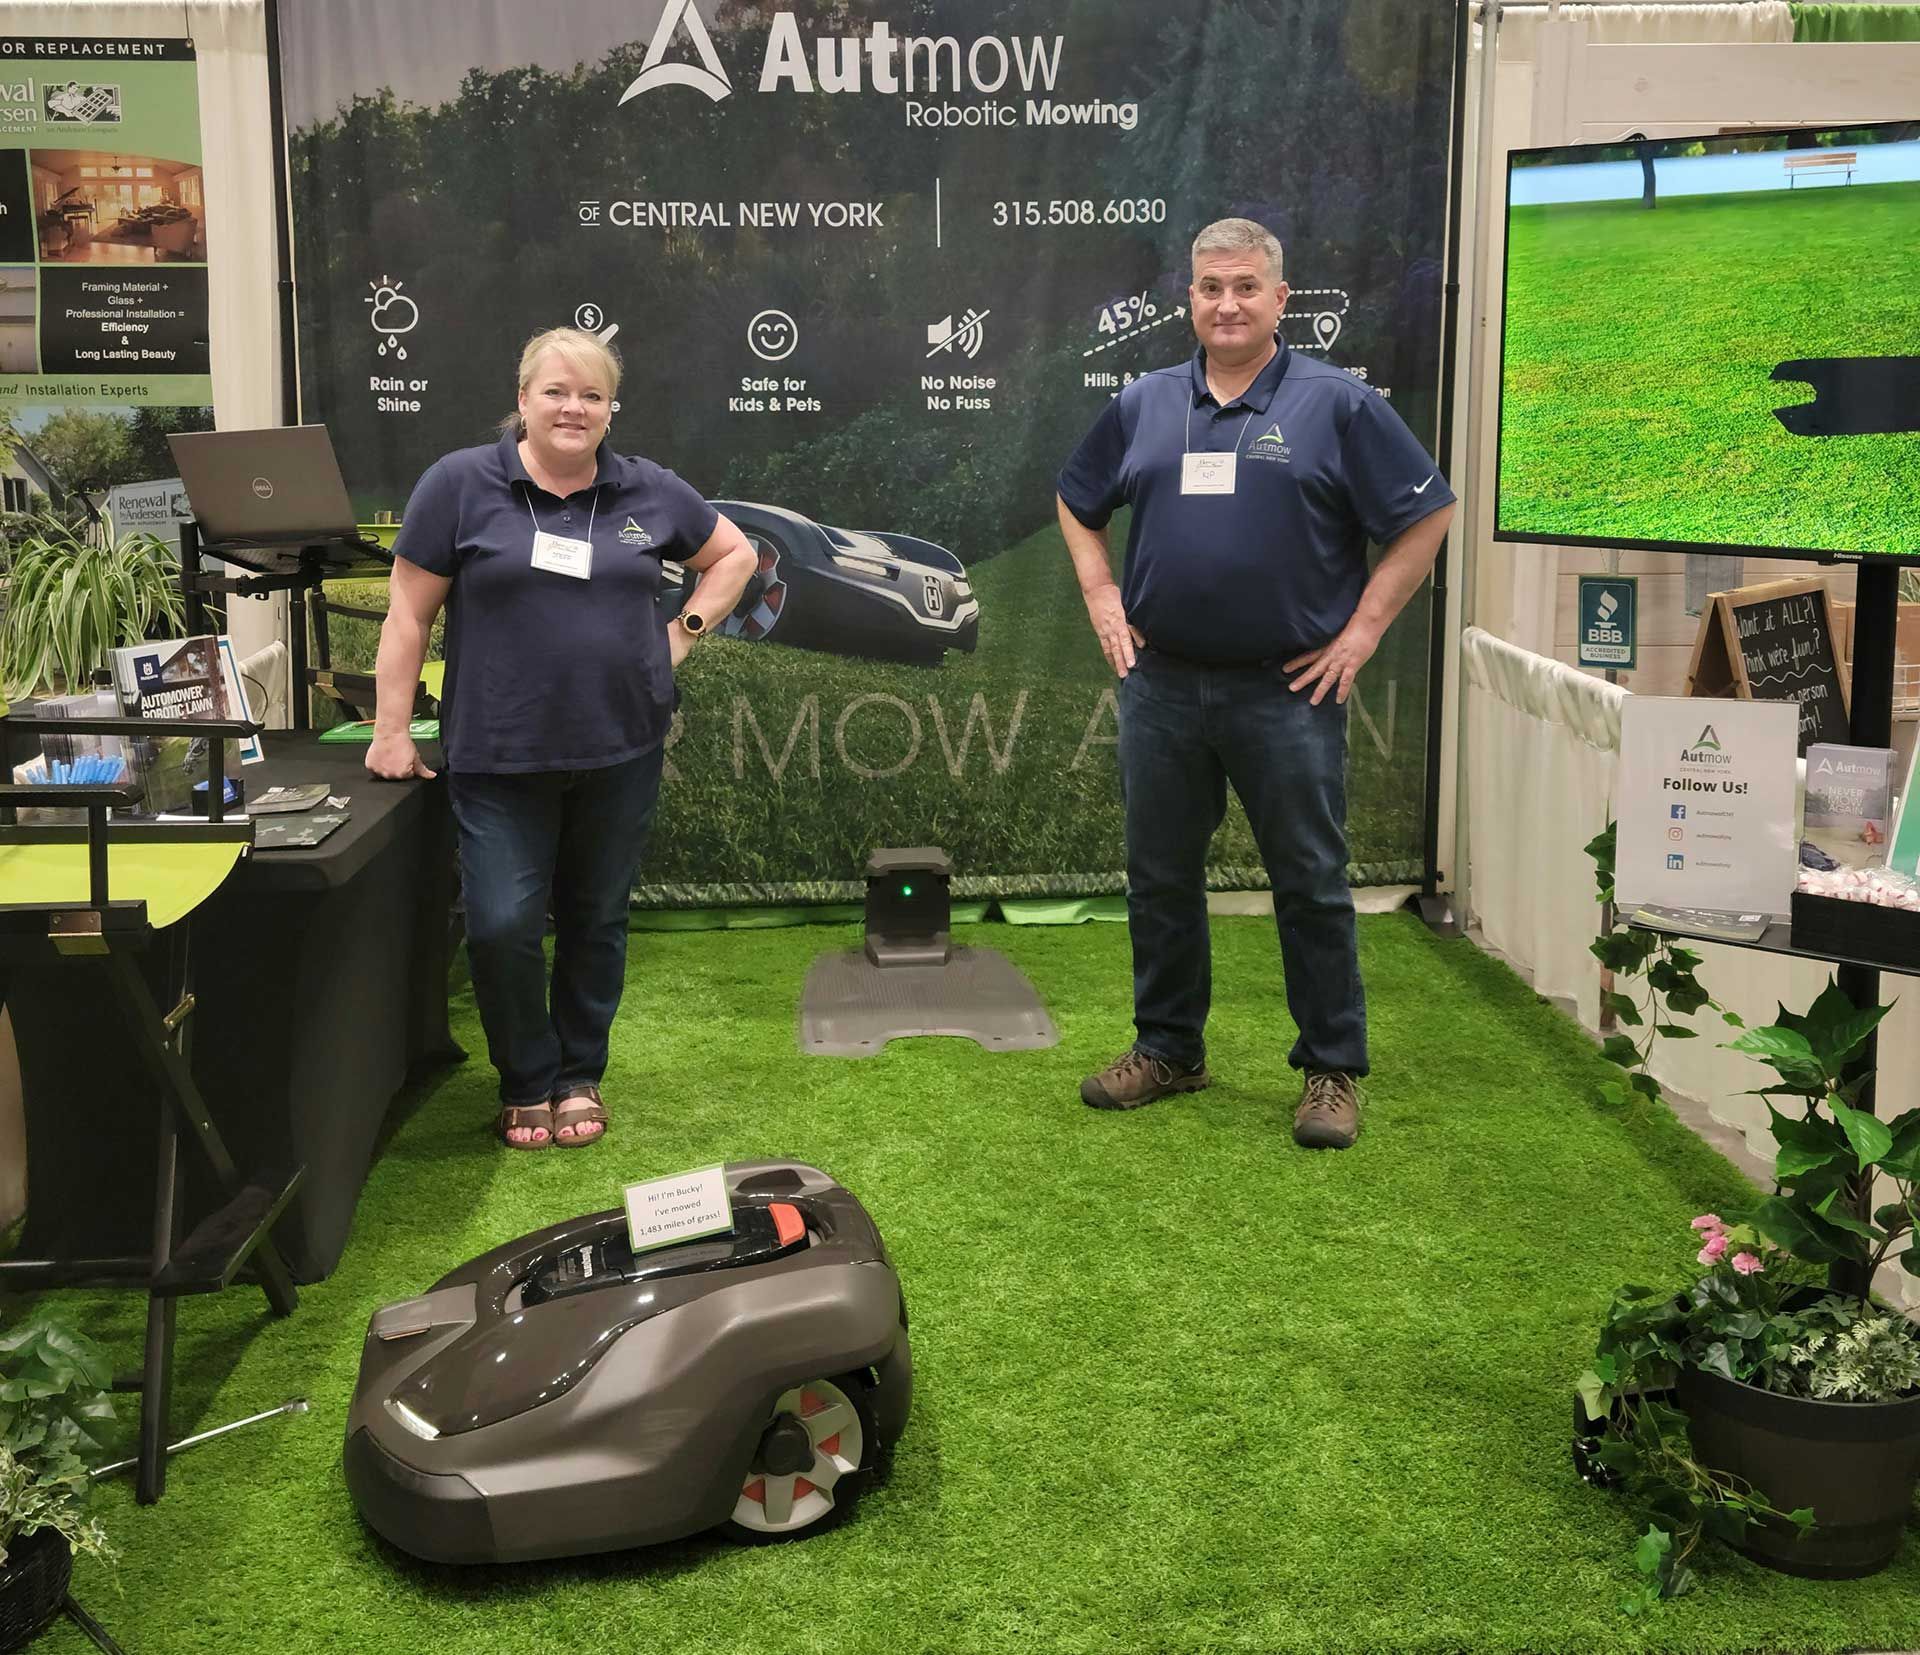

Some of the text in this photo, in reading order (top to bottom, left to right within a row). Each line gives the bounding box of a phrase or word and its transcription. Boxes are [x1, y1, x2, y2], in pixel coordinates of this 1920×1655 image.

[2, 42, 165, 55] OR REPLACEMENT
[758, 12, 1064, 94] Autmow
[906, 99, 1139, 131] Robotic Mowing
[579, 201, 884, 227] OF CENTRAL NEW YORK
[992, 198, 1167, 225] 315.508.6030
[82, 282, 120, 293] Framing
[123, 282, 160, 292] Material
[107, 295, 135, 305] Glass
[65, 309, 123, 318] Professional
[126, 309, 176, 318] Installation
[1098, 290, 1157, 335] 45%
[101, 322, 149, 333] Efficiency
[121, 335, 129, 345] &
[75, 349, 176, 360] Long Lasting Beauty
[1084, 372, 1119, 387] Hills
[1123, 372, 1135, 386] &
[1343, 367, 1368, 380] PS
[370, 376, 428, 392] Rain or
[741, 377, 806, 392] Safe for
[921, 375, 996, 390] No Noise
[25, 384, 96, 396] Installation
[100, 384, 149, 398] Experts
[377, 397, 421, 412] Shine
[729, 397, 822, 412] Kids & Pets
[927, 396, 991, 411] No Fuss
[1248, 439, 1292, 455] Autmow
[120, 491, 166, 509] Renewal
[126, 510, 168, 520] Andersen
[1588, 628, 1623, 643] BBB
[1797, 684, 1828, 712] person
[186, 698, 213, 715] LAWN
[731, 690, 1028, 780] MOW
[1680, 749, 1732, 764] Autmow
[1836, 761, 1881, 776] Autmow
[1663, 777, 1748, 794] Follow Us!
[1828, 786, 1865, 798] NEVER
[1828, 804, 1864, 816] AGAIN
[648, 1184, 704, 1203] Hi! I'm Bucky!
[654, 1200, 701, 1217] I've mowed
[640, 1210, 721, 1237] 1,483 miles of grass!
